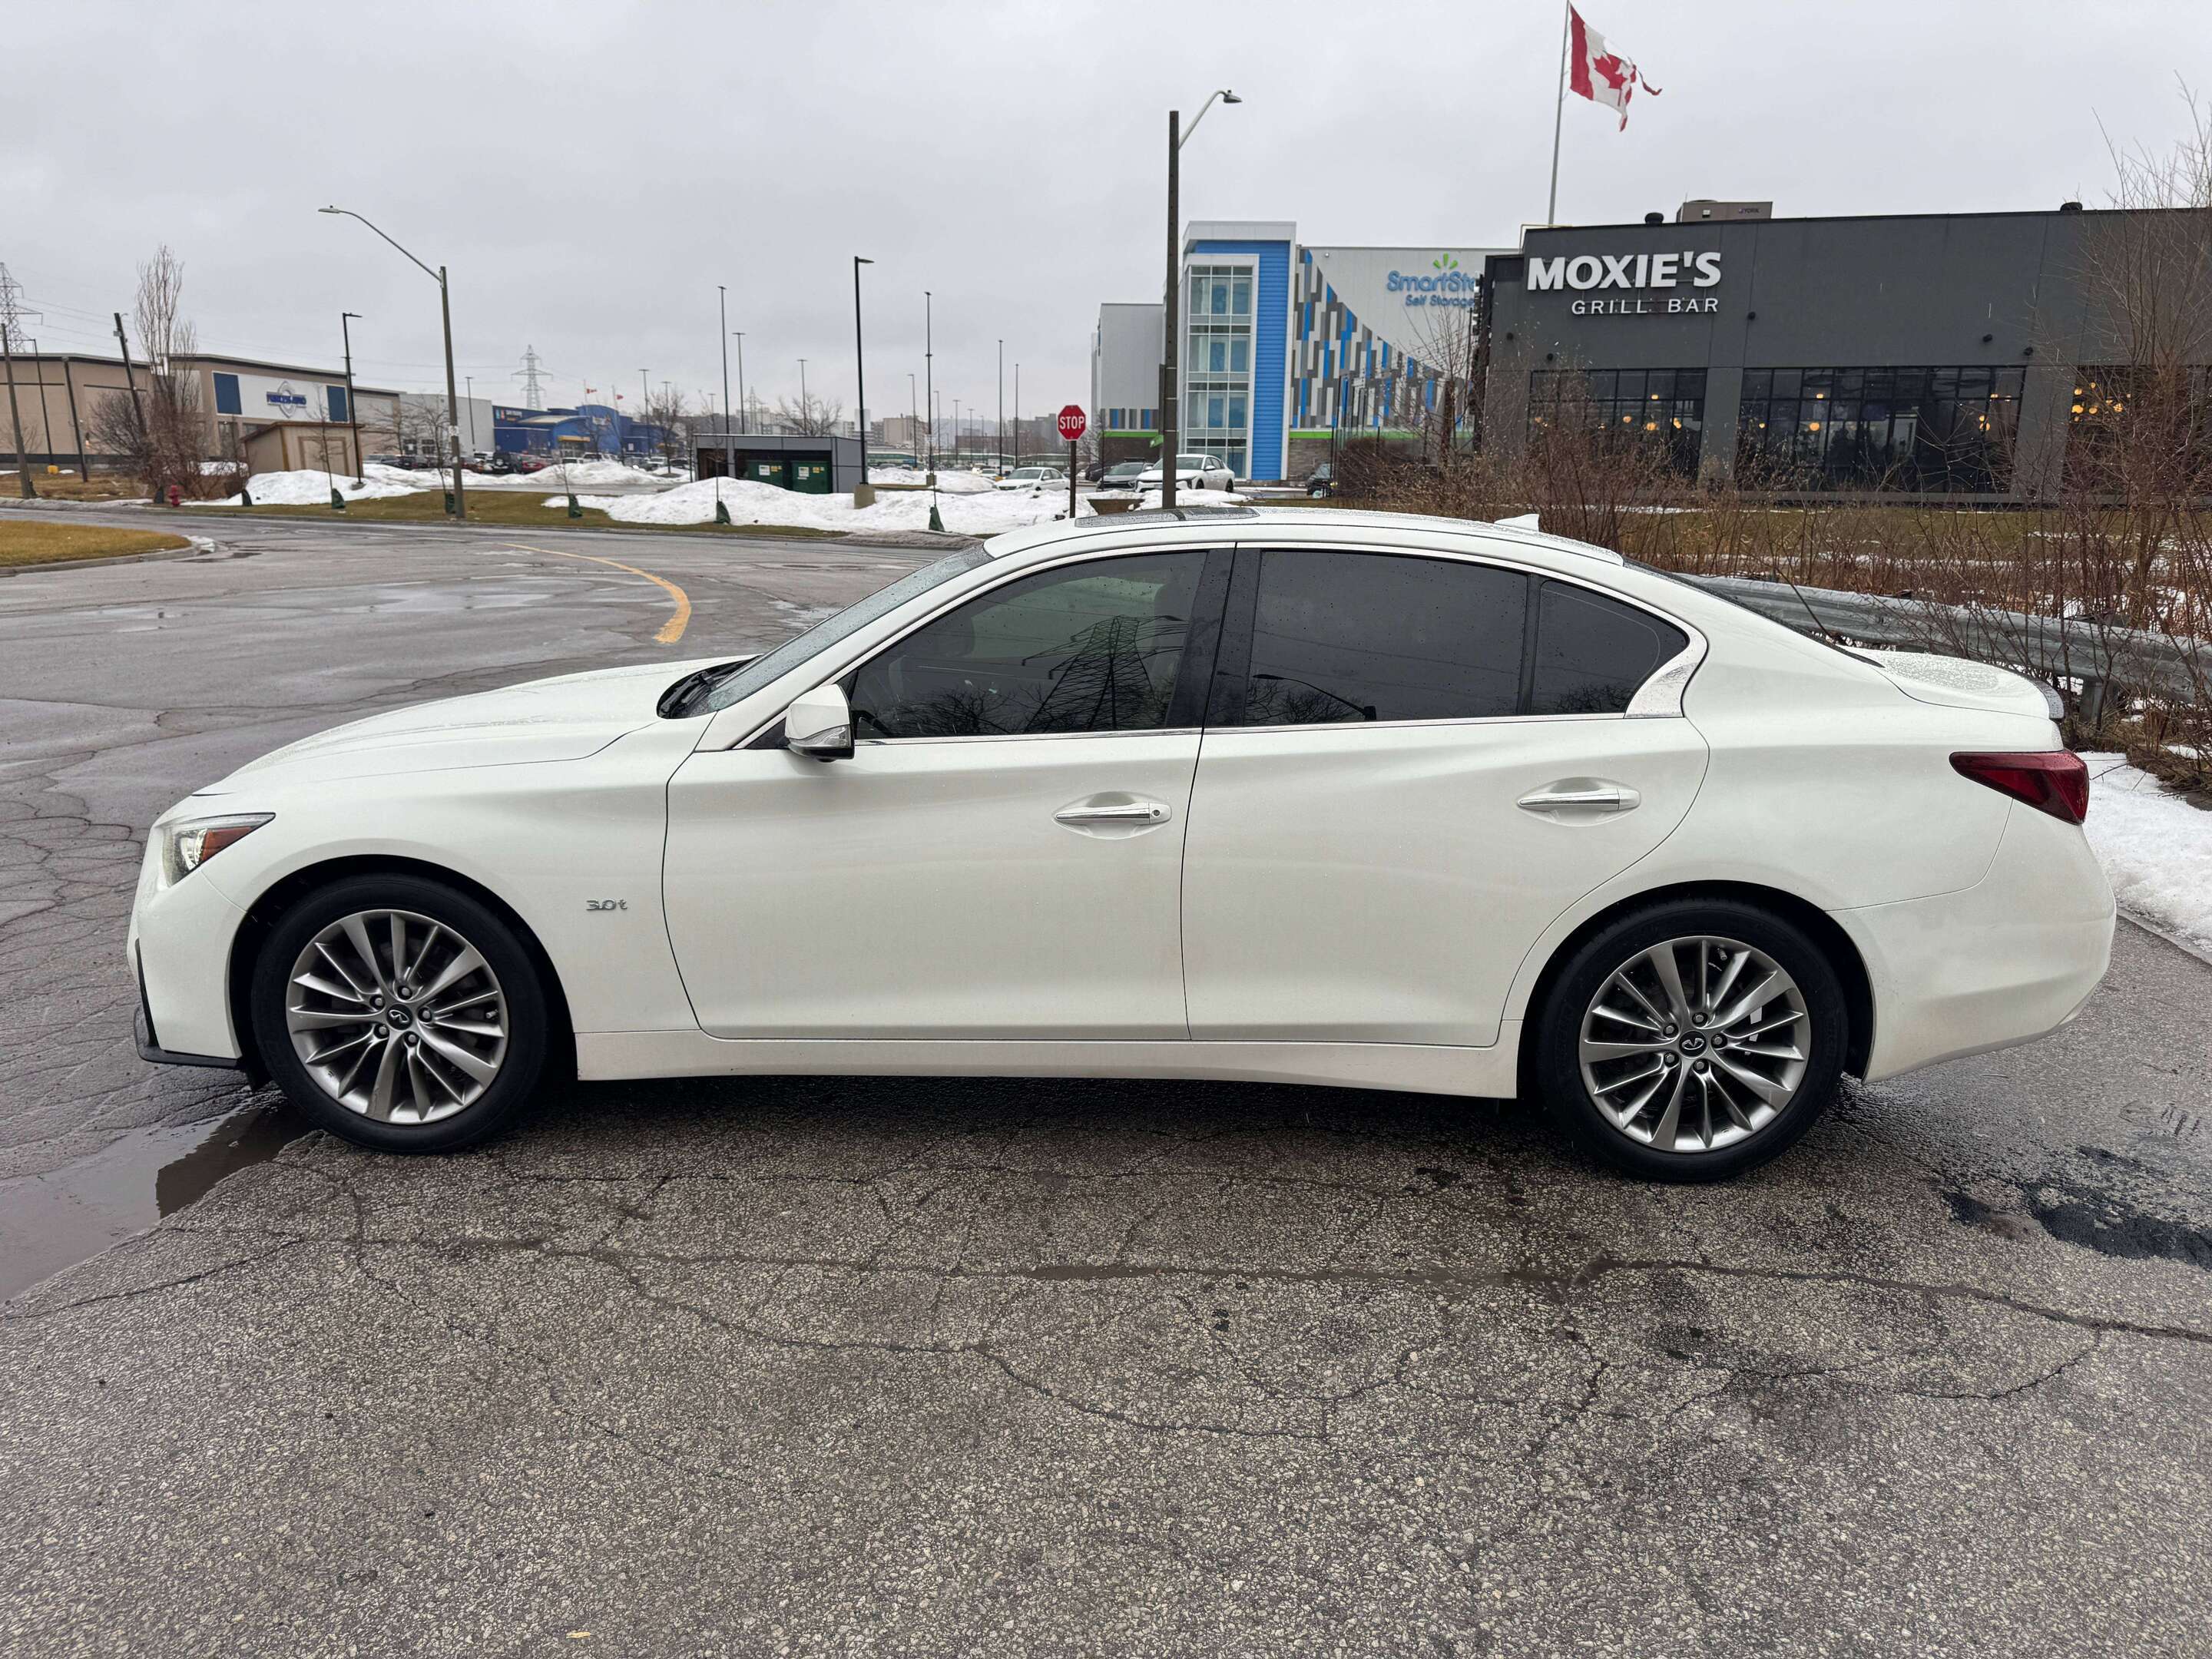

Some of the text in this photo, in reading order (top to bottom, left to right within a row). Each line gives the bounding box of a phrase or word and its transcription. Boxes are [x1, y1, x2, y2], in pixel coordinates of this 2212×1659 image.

[1527, 251, 1721, 290] MOXIE'S
[1406, 295, 1475, 308] Self Storage
[1571, 297, 1718, 315] GRILL BAR
[1059, 416, 1084, 429] STOP
